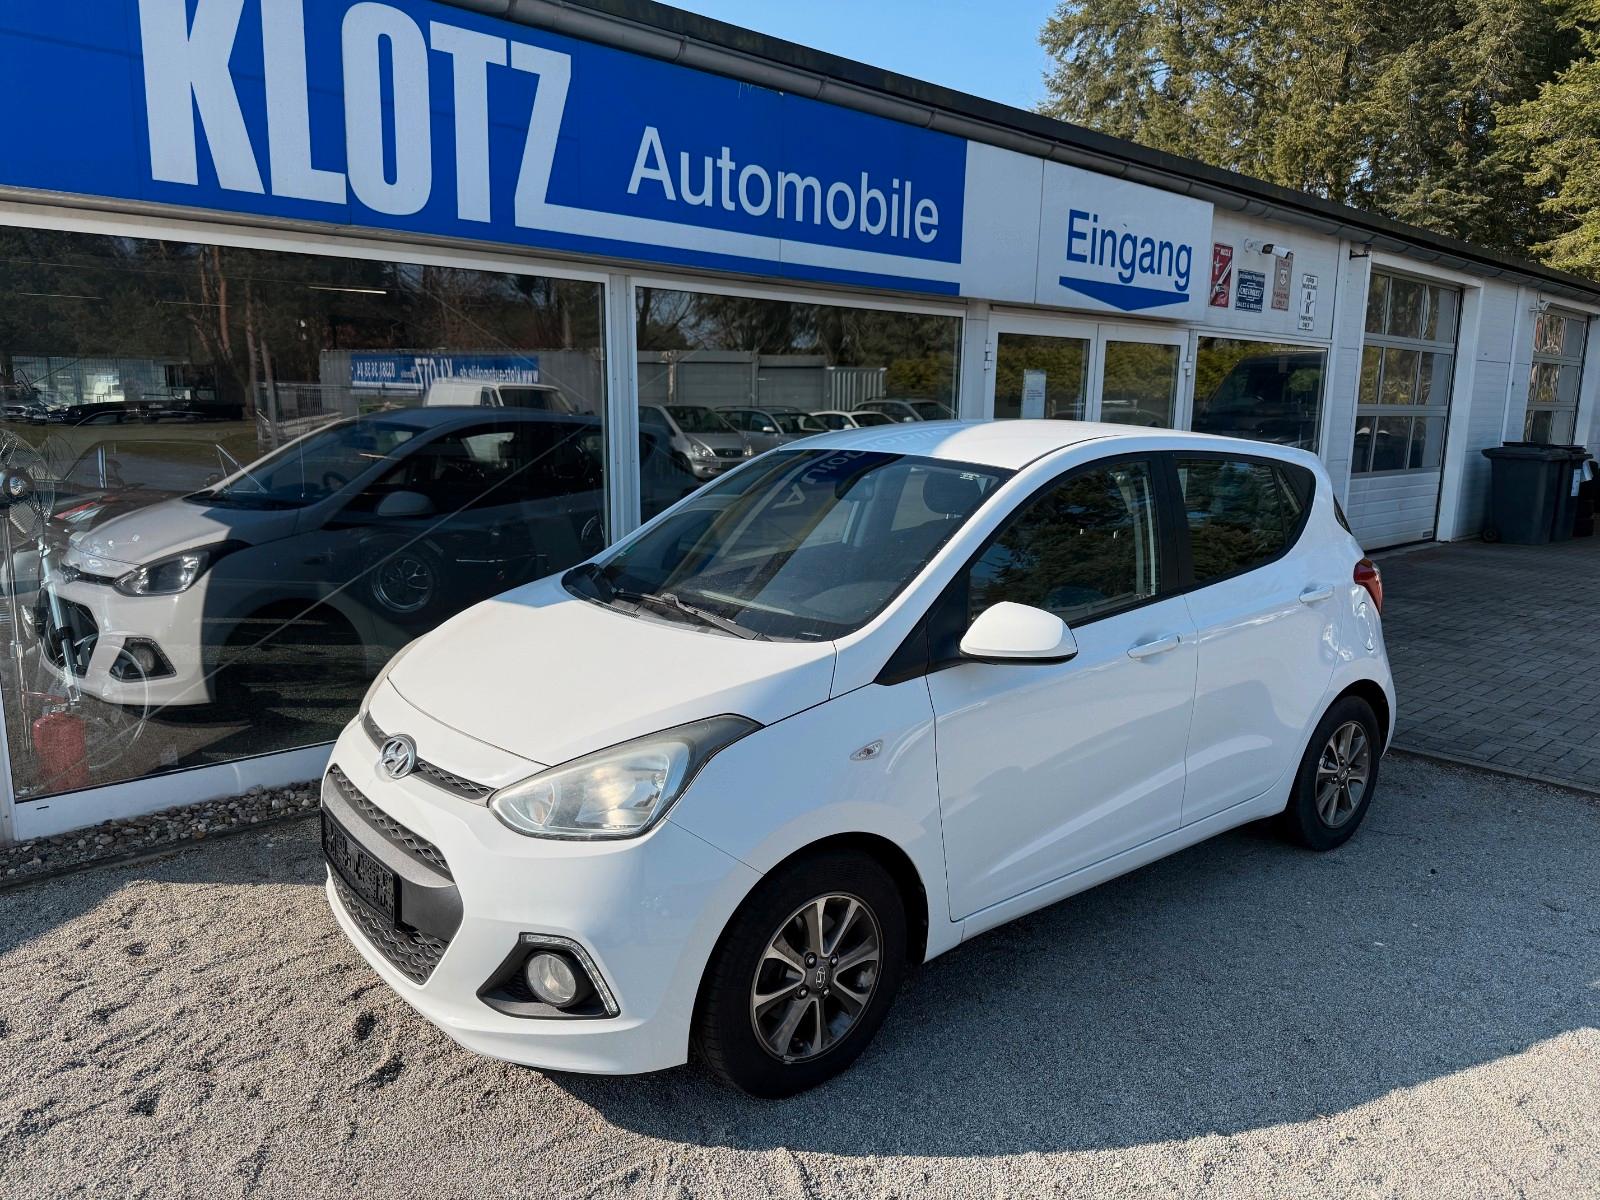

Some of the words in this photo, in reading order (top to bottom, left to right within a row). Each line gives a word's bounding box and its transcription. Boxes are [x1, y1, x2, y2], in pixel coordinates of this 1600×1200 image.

[138, 0, 573, 236] KLOTZ
[626, 125, 939, 244] Automobile
[1066, 208, 1193, 292] Eingang
